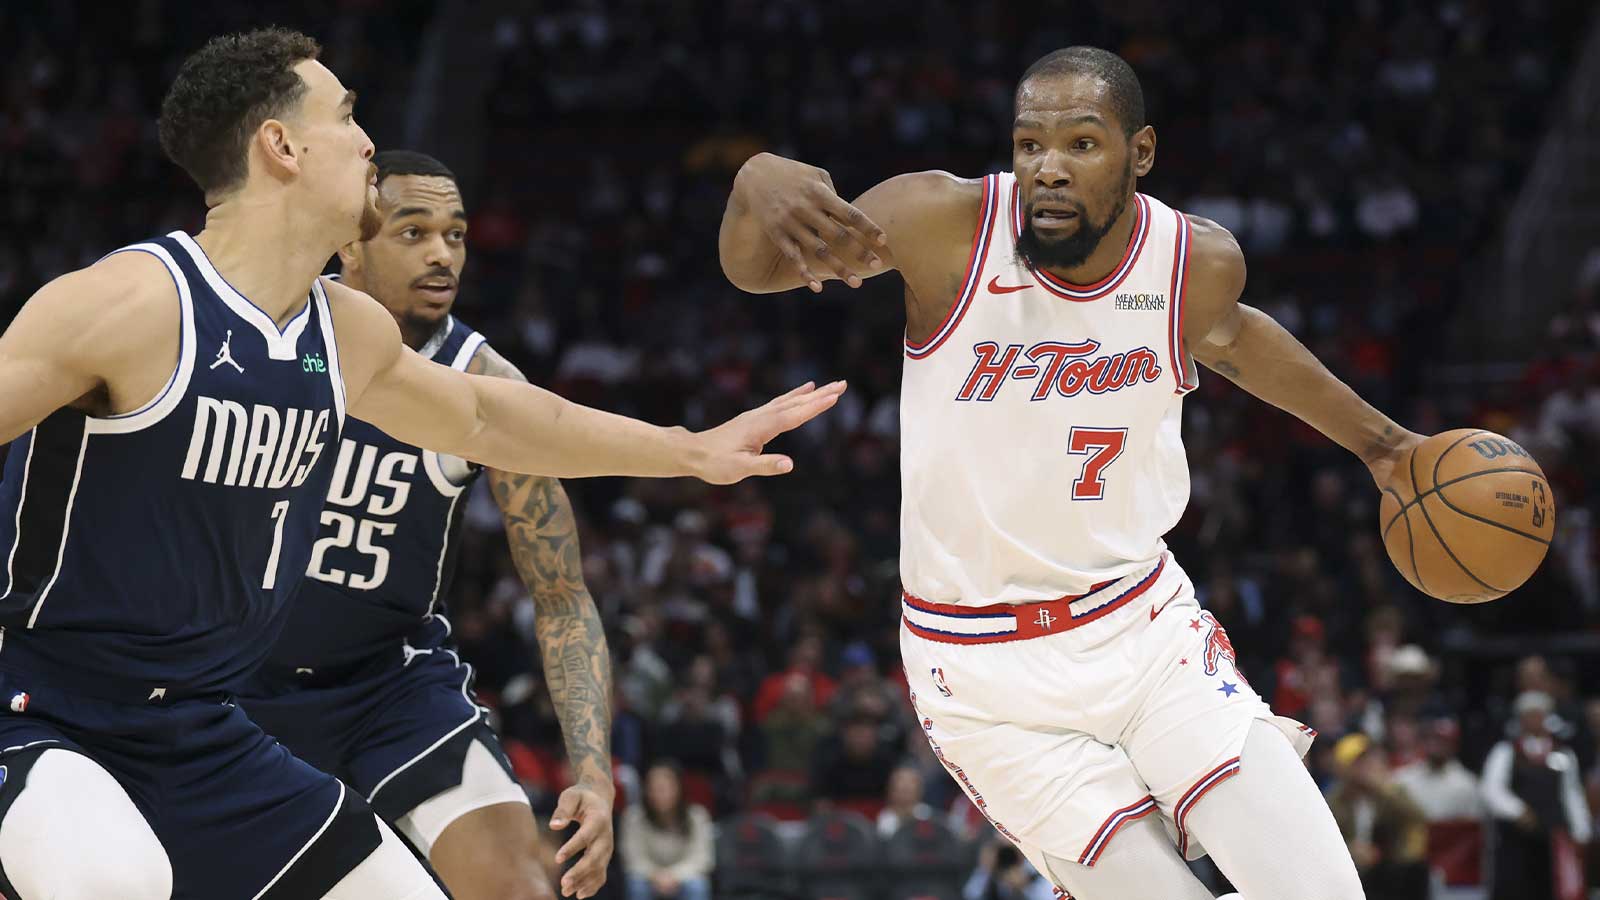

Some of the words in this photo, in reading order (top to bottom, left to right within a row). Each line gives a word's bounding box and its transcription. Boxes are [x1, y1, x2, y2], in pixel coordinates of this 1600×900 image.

[1115, 301, 1165, 310] HERMANN
[1116, 294, 1165, 303] MEMORIAL
[955, 339, 1161, 401] H-Town
[1067, 426, 1128, 500] 7
[305, 510, 397, 590] 25
